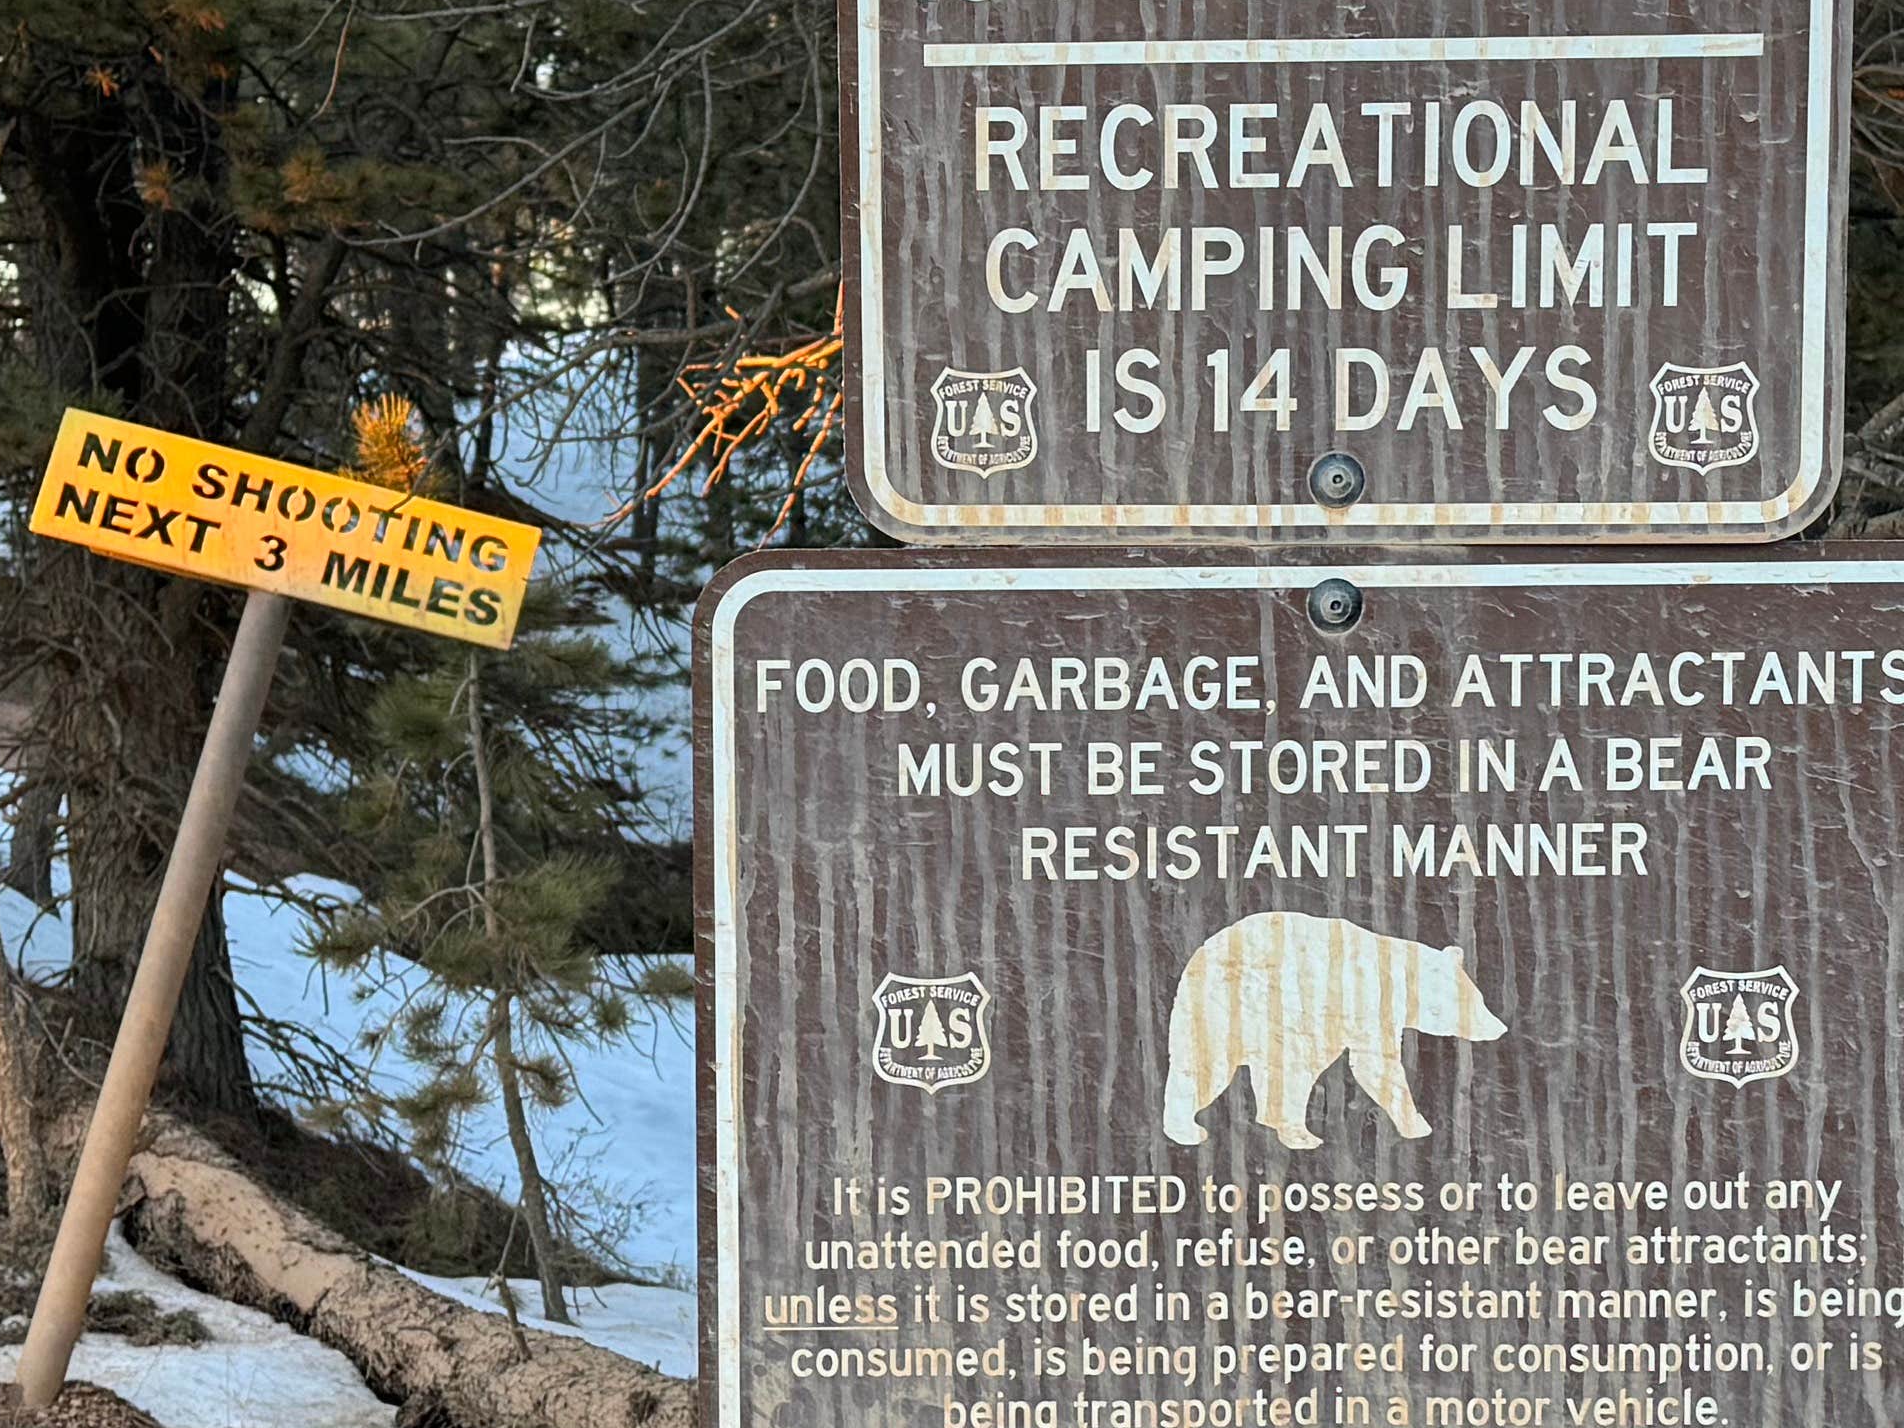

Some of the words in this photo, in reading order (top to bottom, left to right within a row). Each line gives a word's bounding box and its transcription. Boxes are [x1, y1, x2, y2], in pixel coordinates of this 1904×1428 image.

[975, 98, 1708, 191] RECREATIONAL
[985, 225, 1409, 314] CAMPING
[1447, 222, 1696, 309] LIMIT
[938, 380, 980, 400] FOREST
[982, 380, 1028, 399] SERVICE
[1086, 346, 1165, 434] IS
[1206, 348, 1297, 432] 14
[1335, 344, 1598, 431] DAYS
[1657, 375, 1700, 395] FOREST
[1703, 375, 1751, 394] SERVICE
[77, 432, 165, 484] NO
[192, 463, 510, 573] SHOOTING
[55, 483, 221, 555] NEXT
[254, 535, 288, 572] 3
[321, 551, 502, 627] MILES
[757, 658, 937, 720] FOOD,
[962, 654, 1277, 716] GARBAGE,
[1300, 652, 1426, 709] AND
[898, 742, 1062, 797] MUST
[1087, 740, 1164, 796] BE
[1189, 738, 1431, 795] STORED
[1460, 738, 1516, 792] IN
[1539, 738, 1583, 792] A
[1607, 735, 1772, 791] BEAR
[1021, 824, 1369, 882] RESISTANT
[1391, 821, 1650, 879] MANNER
[881, 987, 925, 1008] FOREST
[930, 986, 980, 1006] SERVICE
[1689, 980, 1735, 1001] FOREST
[1738, 980, 1789, 1000] SERVICE
[833, 1177, 861, 1215] It
[877, 1178, 910, 1215] is
[927, 1175, 1186, 1215] PROHIBITED
[1202, 1176, 1242, 1213] to
[1258, 1178, 1424, 1223] possess
[1439, 1180, 1482, 1211] or
[1497, 1174, 1538, 1211] to
[1555, 1173, 1668, 1211] leave
[1683, 1172, 1749, 1210] out
[1764, 1178, 1842, 1221] any
[804, 1231, 1041, 1270] unattended
[1056, 1231, 1160, 1272] food,
[1175, 1228, 1316, 1269] refuse,
[1332, 1234, 1373, 1265] or
[1389, 1228, 1499, 1265] other
[1515, 1227, 1609, 1265] bear
[1626, 1225, 1868, 1266] attractants;
[764, 1285, 898, 1326] unless
[914, 1285, 940, 1323] it
[957, 1285, 990, 1323] is
[1005, 1284, 1138, 1323] stored
[1154, 1283, 1190, 1322] in
[1206, 1291, 1229, 1322] a
[1245, 1280, 1541, 1322] bear-resistant
[1557, 1286, 1727, 1322] manner,
[1744, 1281, 1777, 1318] is
[792, 1338, 1016, 1380] consumed,
[1033, 1338, 1066, 1377] is
[1082, 1337, 1196, 1385] being
[1213, 1334, 1404, 1385] prepared
[1418, 1334, 1477, 1372] for
[1493, 1333, 1773, 1383] consumption,
[1789, 1338, 1833, 1372] or
[1849, 1333, 1882, 1371] is
[1334, 1387, 1369, 1425] in
[1386, 1393, 1410, 1425] a
[1425, 1389, 1550, 1426] motor
[1565, 1387, 1729, 1426] vehicle.
